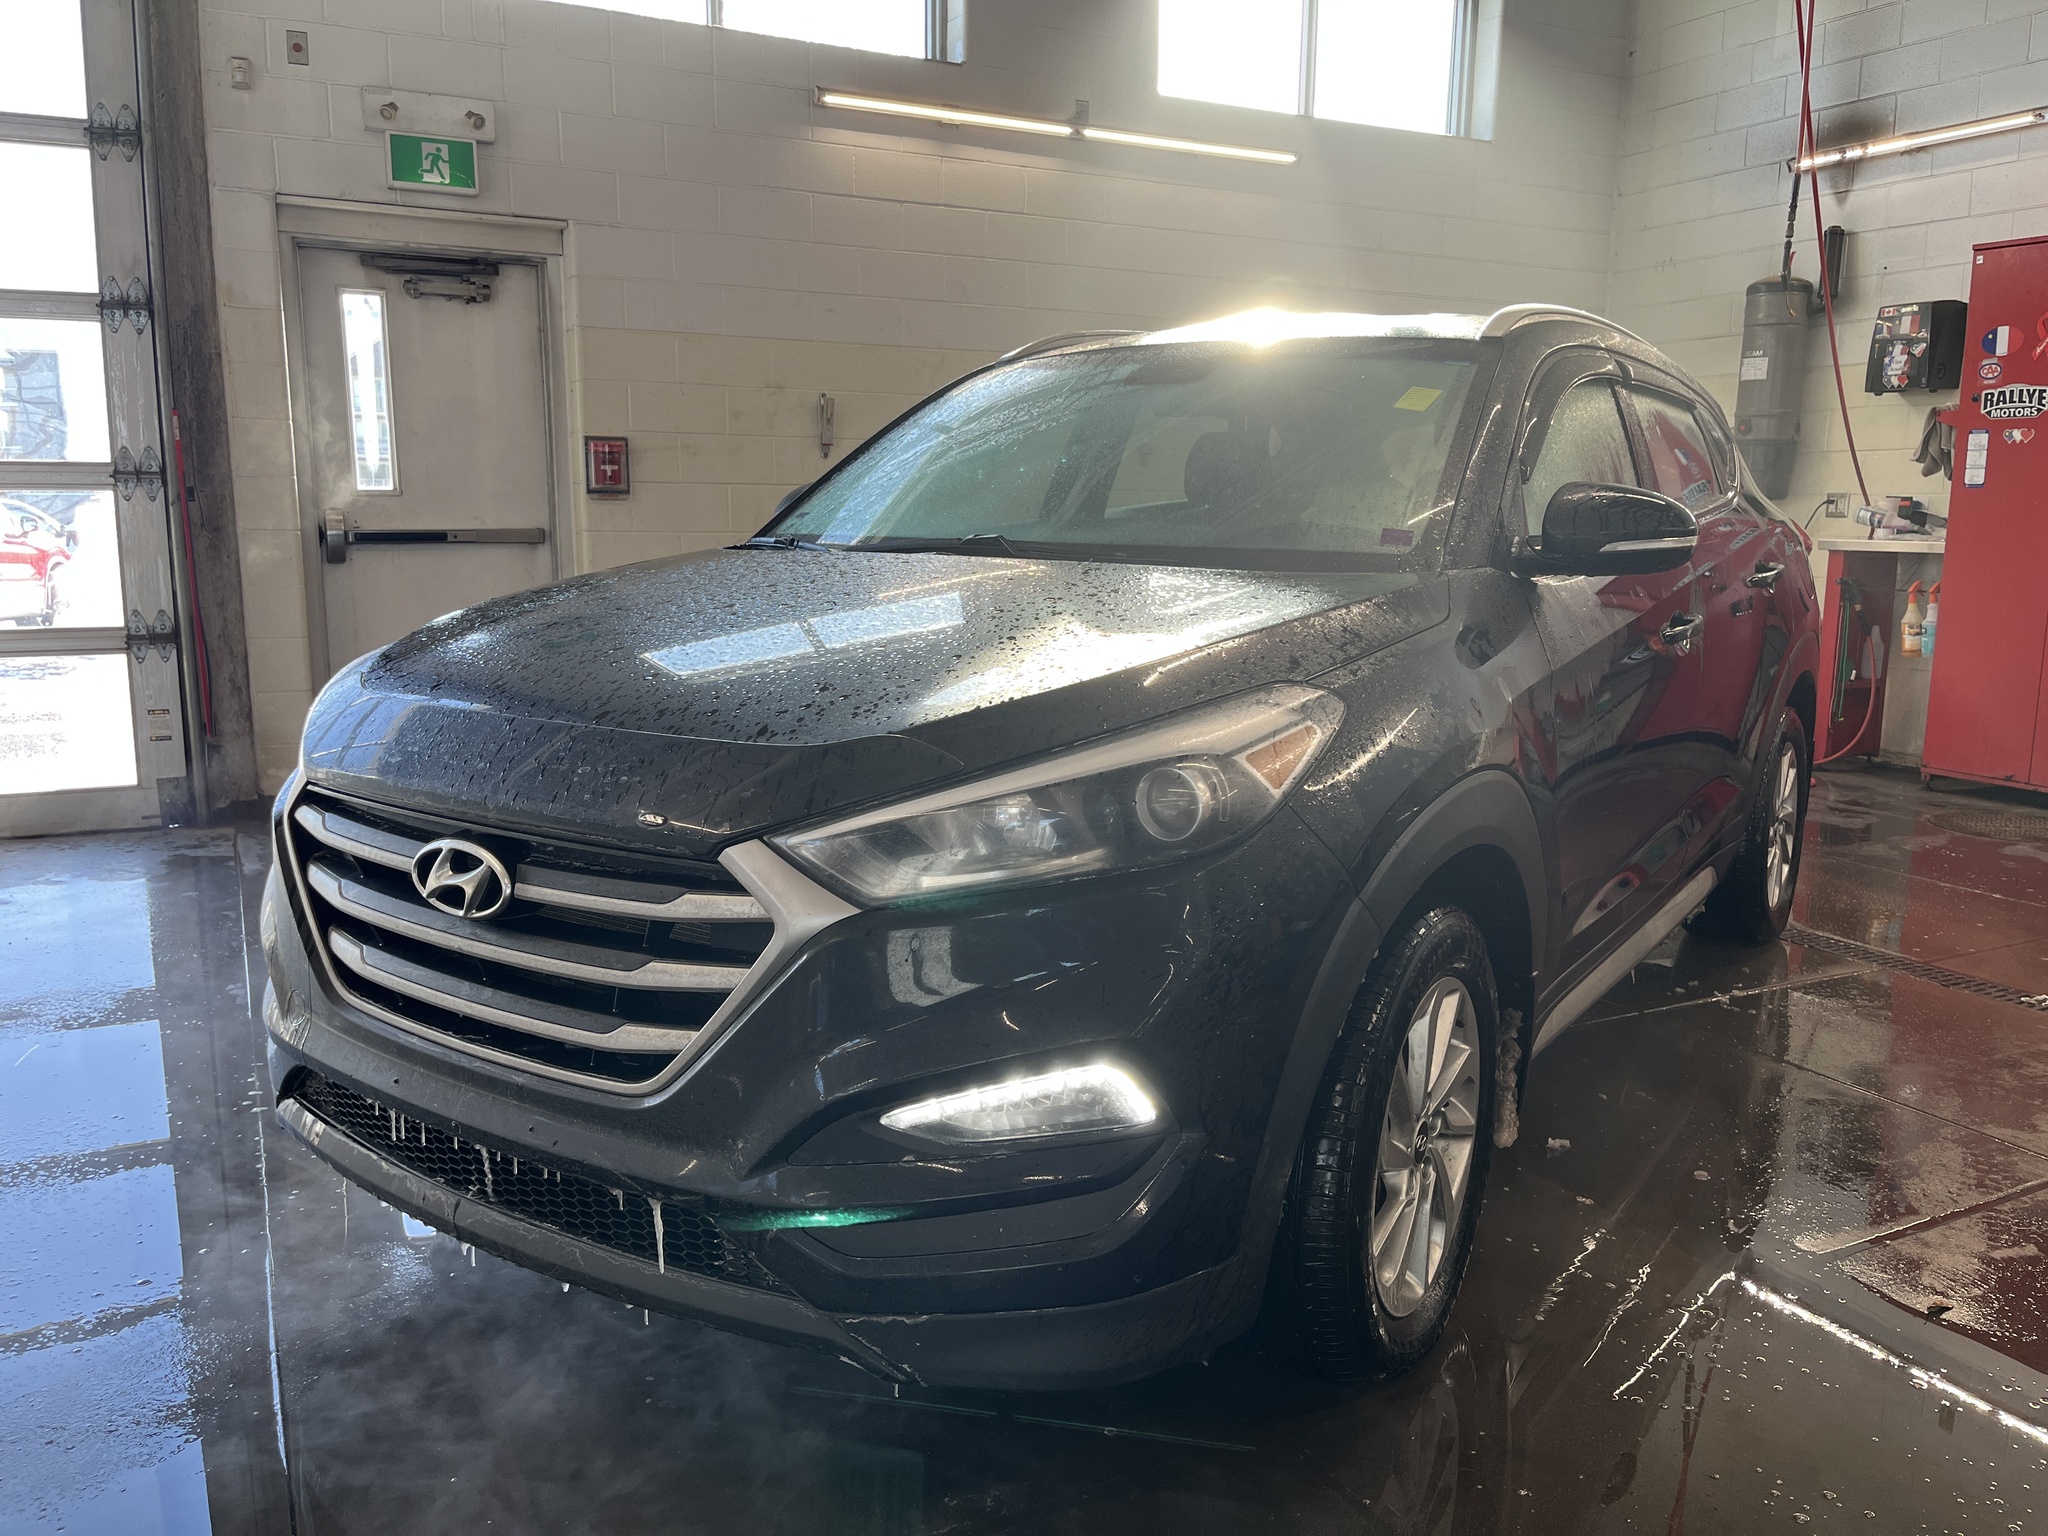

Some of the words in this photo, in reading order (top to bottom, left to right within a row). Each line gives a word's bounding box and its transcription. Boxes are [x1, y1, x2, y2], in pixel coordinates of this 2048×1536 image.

[1981, 365, 1999, 377] CAA
[1983, 388, 2047, 411] RALLYE
[1990, 407, 2038, 418] MOTORS
